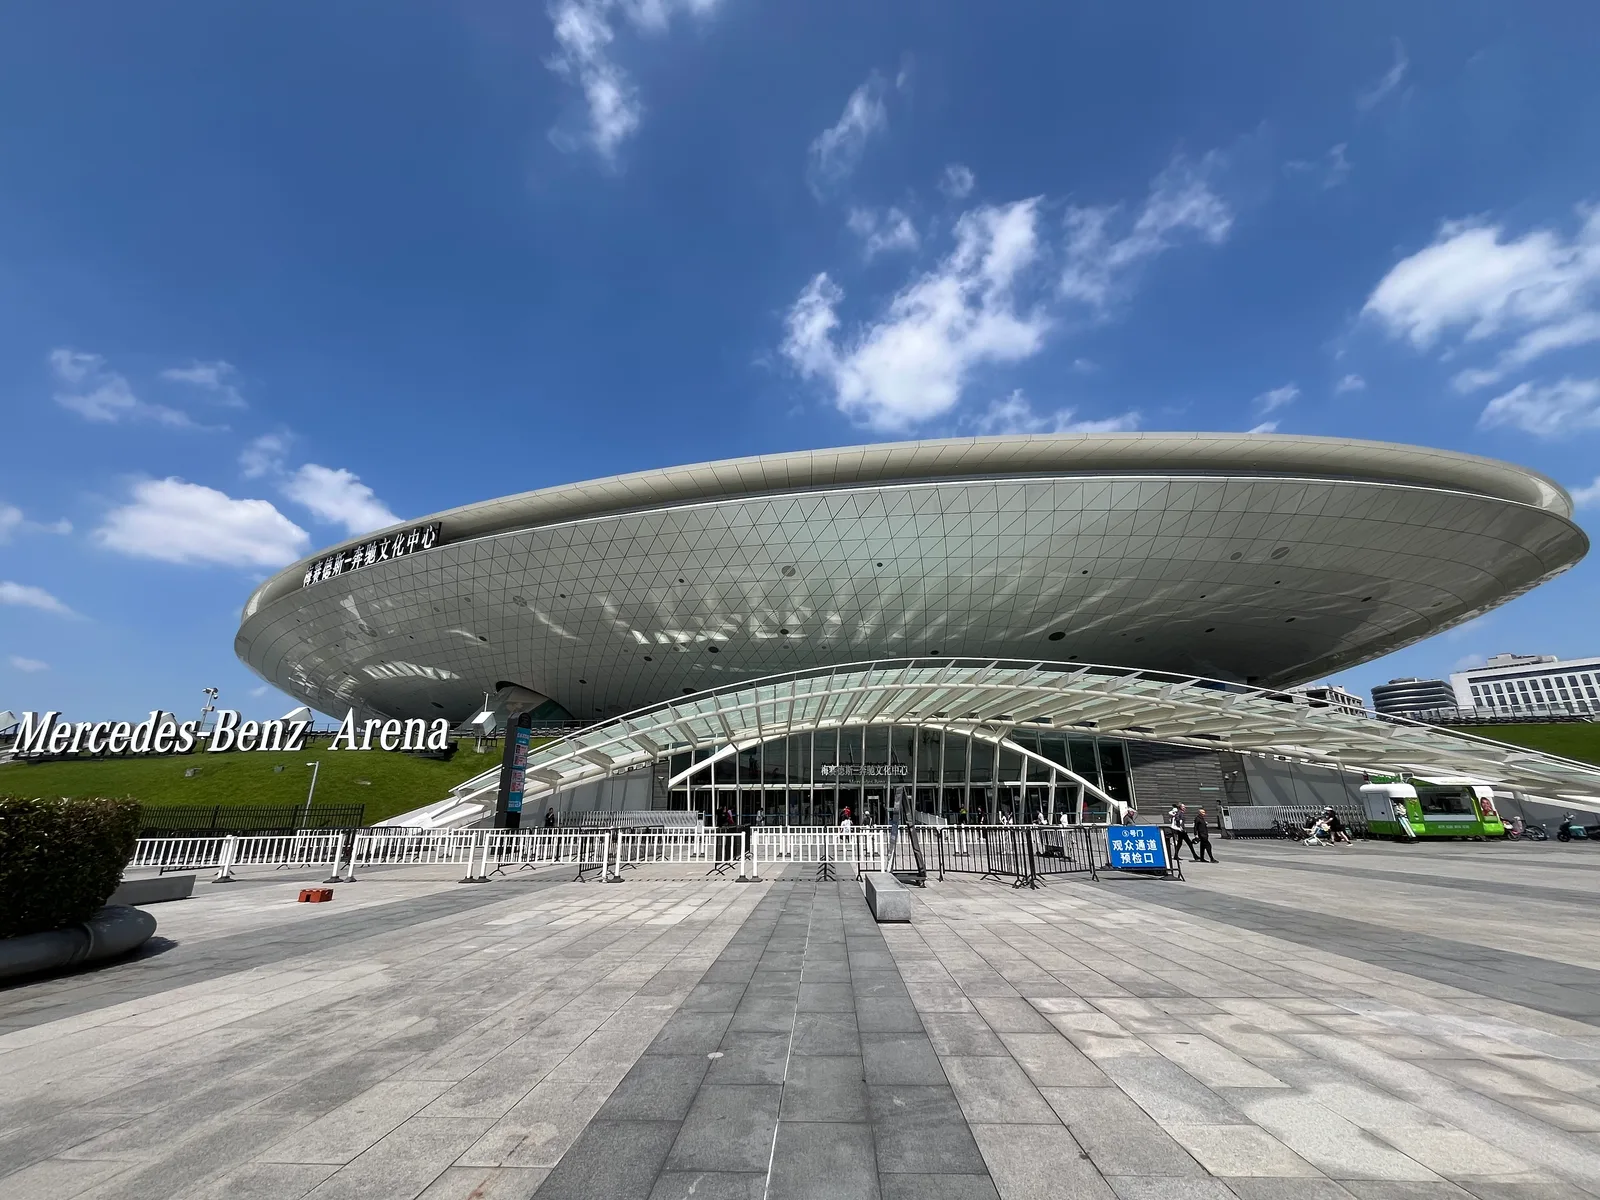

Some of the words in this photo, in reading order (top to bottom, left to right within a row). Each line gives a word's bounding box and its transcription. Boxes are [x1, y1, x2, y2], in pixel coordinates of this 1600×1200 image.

[9, 709, 304, 753] Mercedes-Benz
[328, 707, 448, 751] Arena
[1112, 839, 1158, 851] 观众通道
[1120, 852, 1154, 864] 预检口
